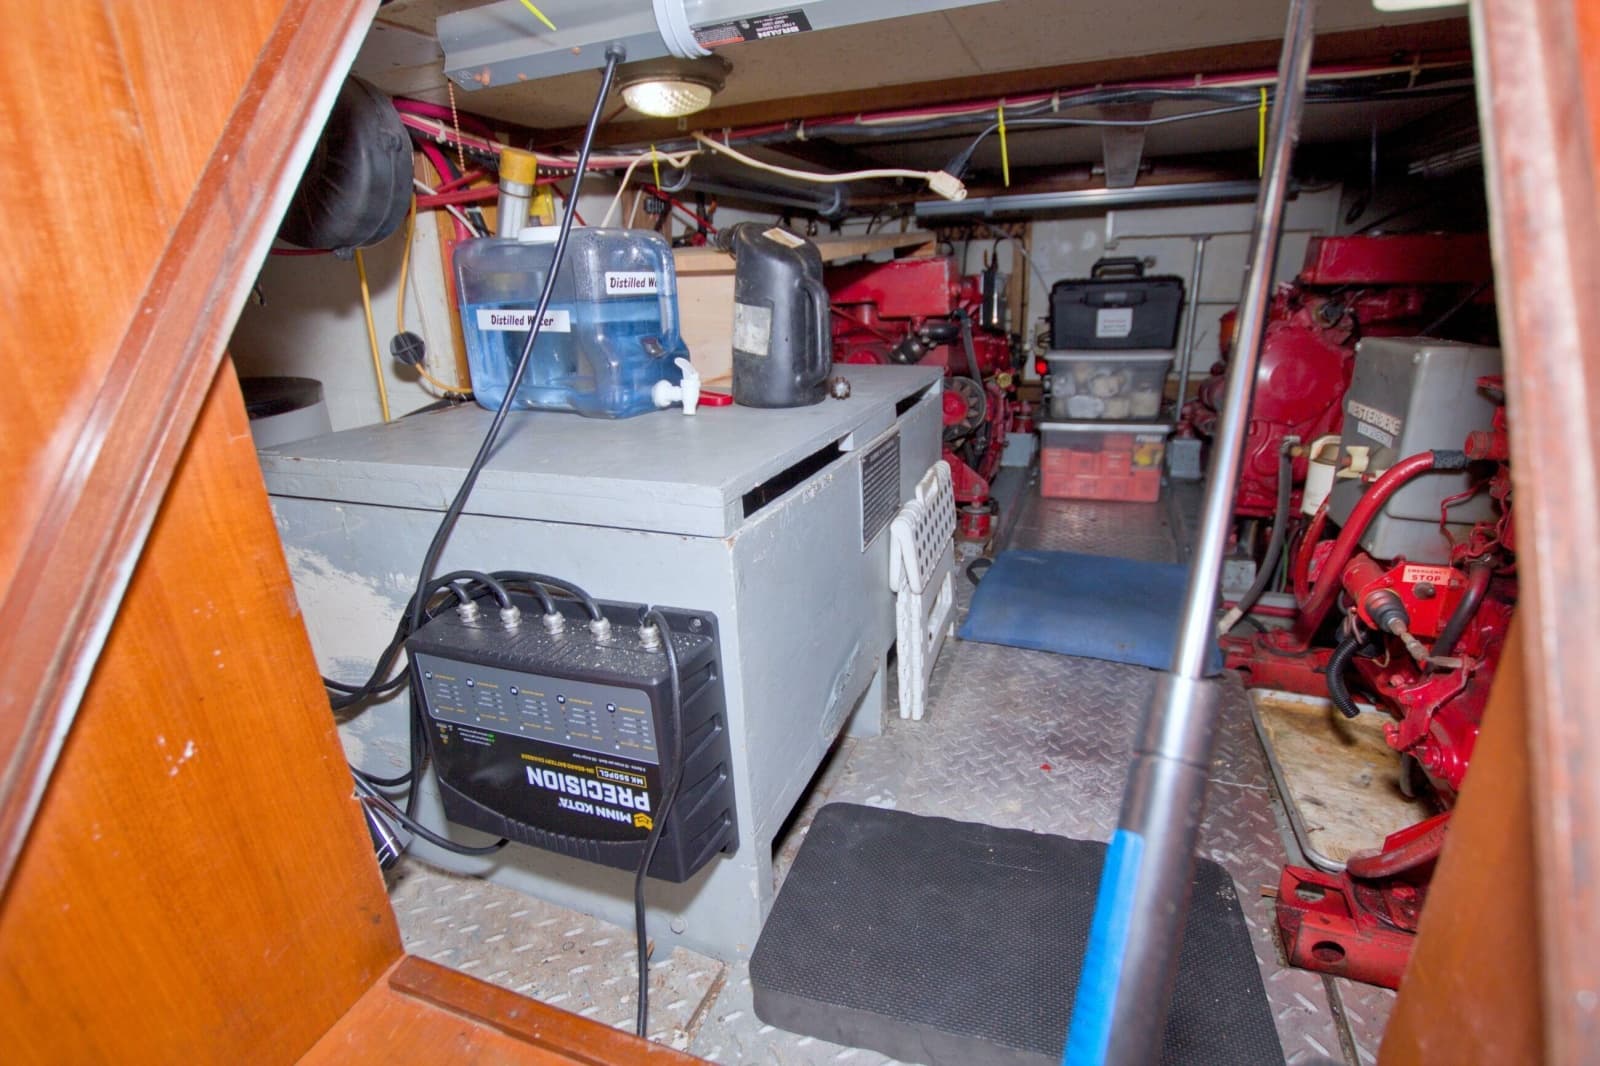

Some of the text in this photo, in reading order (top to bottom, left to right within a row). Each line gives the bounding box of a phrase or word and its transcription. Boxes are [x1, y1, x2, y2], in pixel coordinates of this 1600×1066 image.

[757, 26, 800, 39] BRAUN
[610, 277, 646, 289] Distilled
[491, 314, 554, 327] Distilled Wer
[630, 775, 644, 785] MK
[526, 766, 651, 812] PRECISION
[559, 797, 632, 824] MINN KOTA
